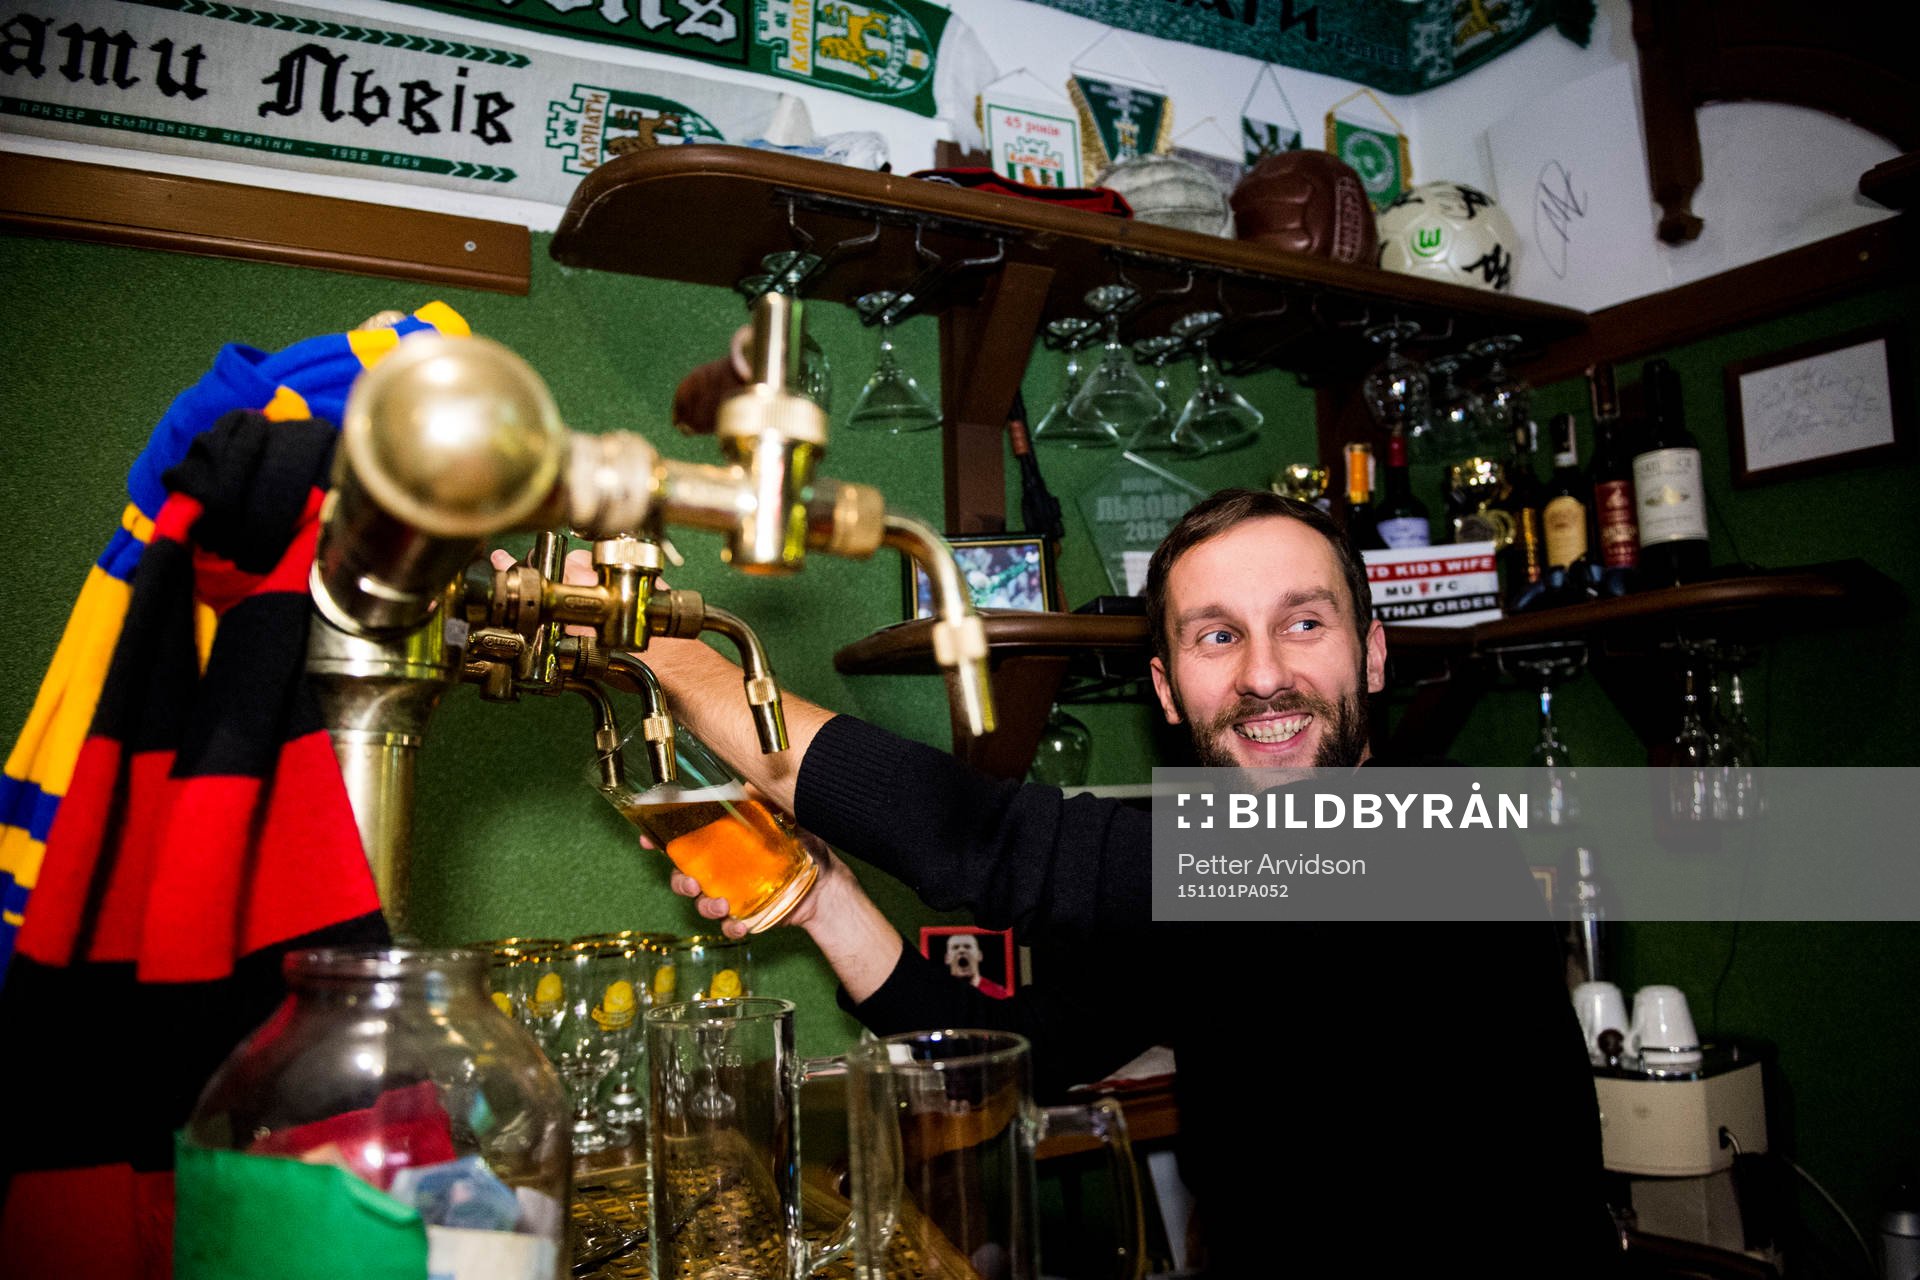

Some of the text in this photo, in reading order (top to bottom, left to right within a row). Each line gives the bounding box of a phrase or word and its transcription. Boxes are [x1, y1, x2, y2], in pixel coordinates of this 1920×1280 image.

[19, 102, 86, 120] ПРИЗЕР
[1005, 115, 1022, 129] 45
[1366, 556, 1493, 579] TD KIDS WIFE
[1381, 603, 1429, 619] THAT
[1432, 595, 1496, 614] ORDER
